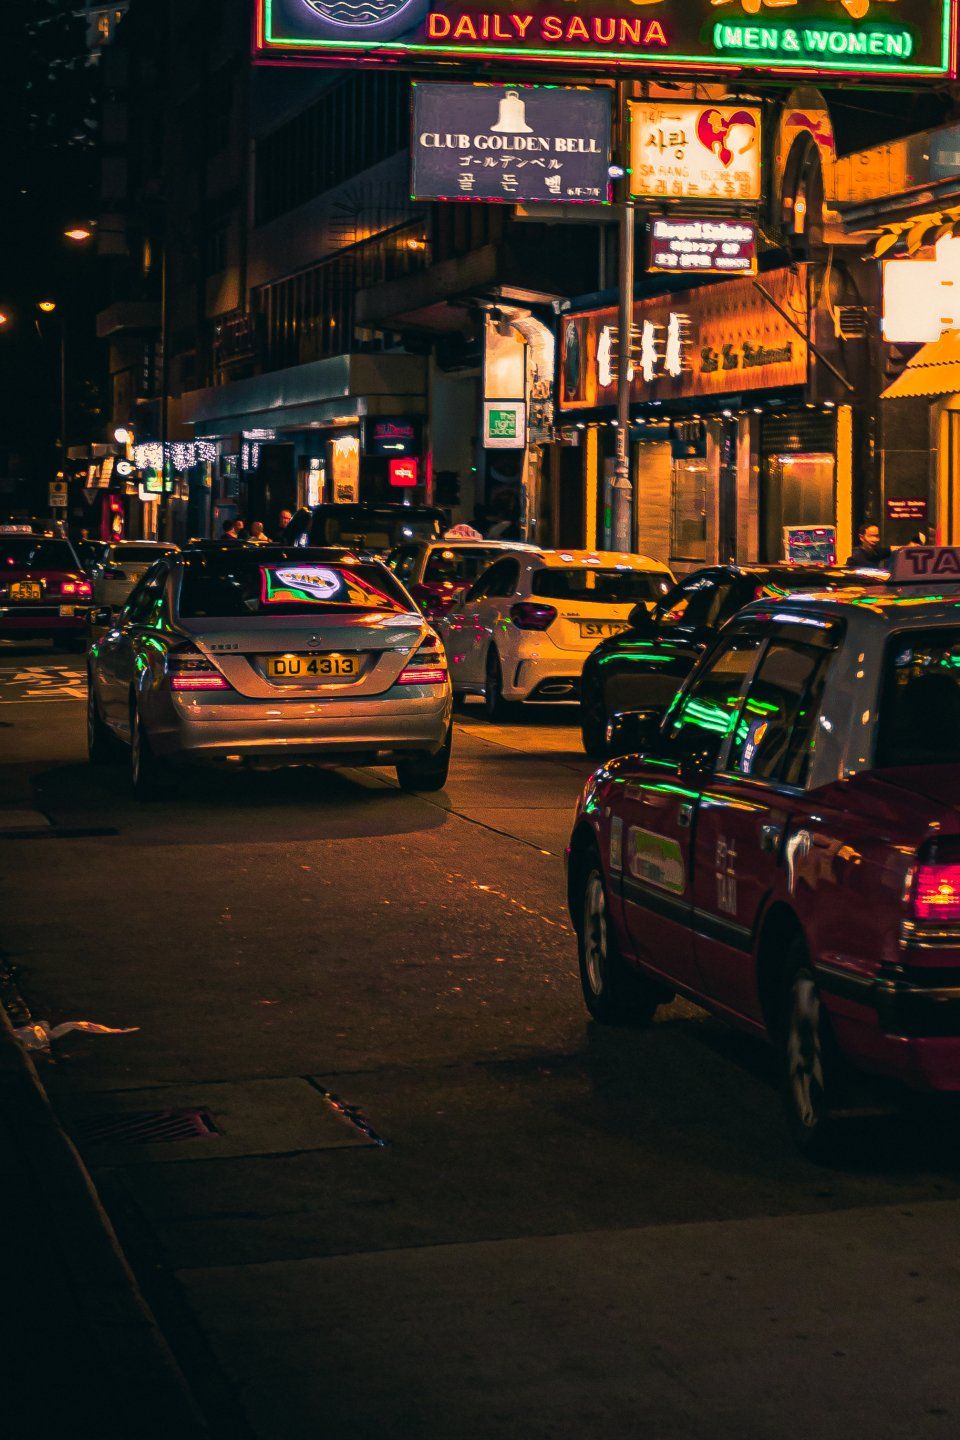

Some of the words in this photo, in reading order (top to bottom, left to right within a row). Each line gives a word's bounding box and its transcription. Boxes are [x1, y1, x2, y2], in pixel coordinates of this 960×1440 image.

[428, 12, 533, 39] DAILY
[541, 16, 668, 45] SAUNA
[713, 23, 783, 50] (MEN
[783, 32, 799, 51] &
[804, 30, 912, 58] WOMEN)
[419, 132, 471, 149] CLUB
[473, 134, 550, 152] GOLDEN
[555, 137, 602, 153] BELL
[644, 128, 689, 161] 사랑
[458, 155, 564, 170] ゴールデンベル
[274, 660, 301, 675] DU
[306, 660, 354, 674] 4313
